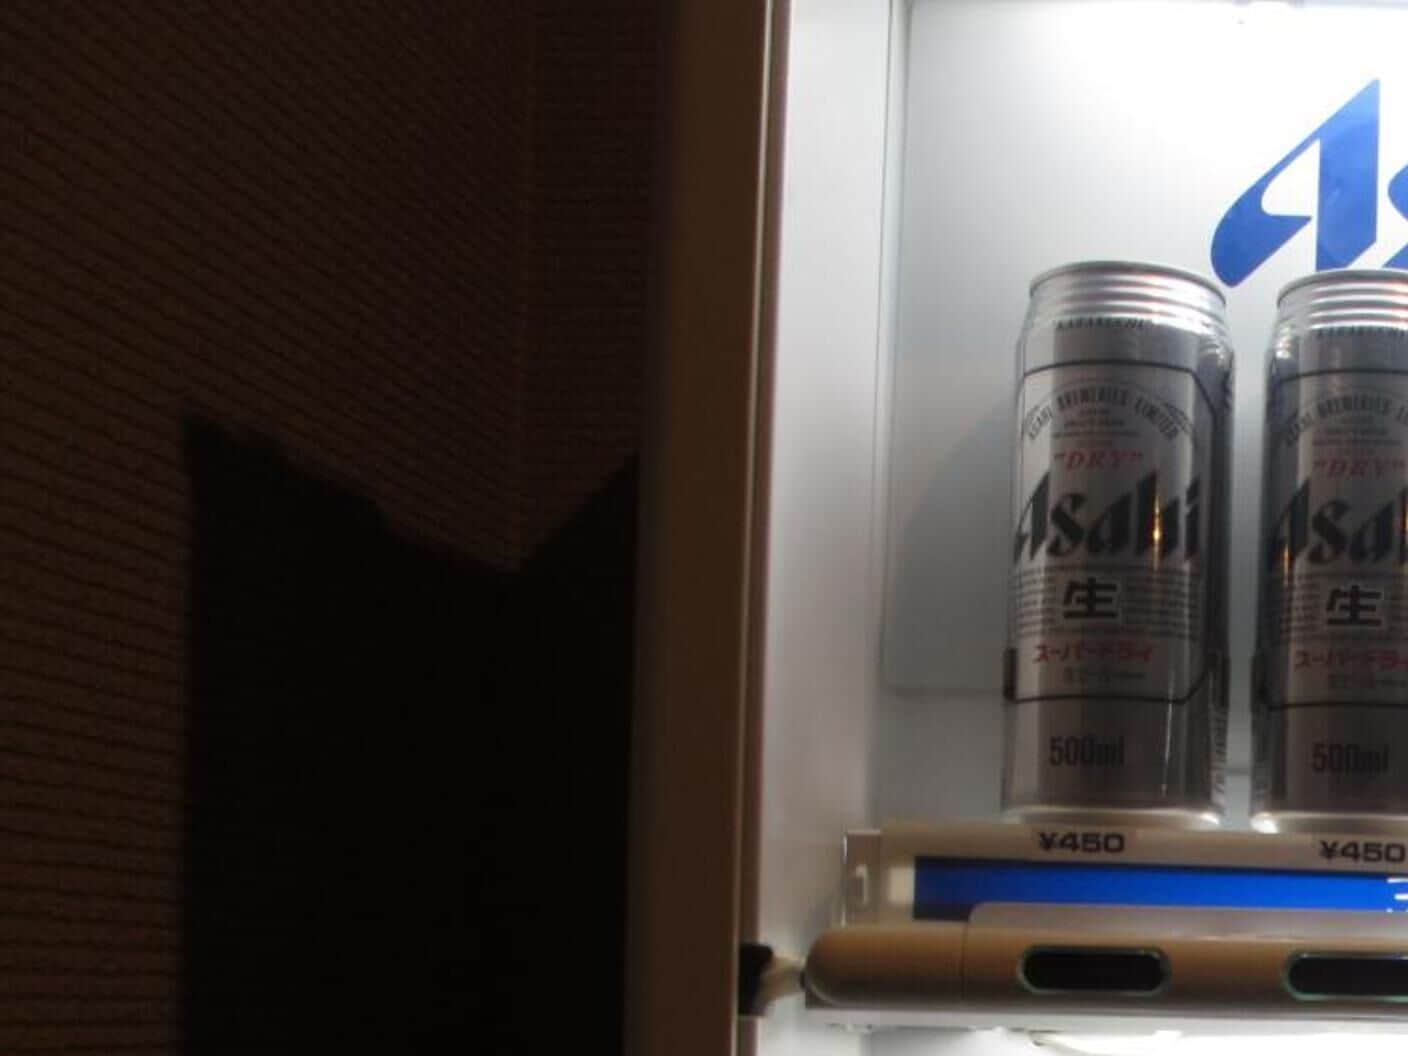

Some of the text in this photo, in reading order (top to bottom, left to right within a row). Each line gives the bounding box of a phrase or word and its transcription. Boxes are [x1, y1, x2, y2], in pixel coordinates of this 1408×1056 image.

[1011, 470, 1201, 562] Asahi
[1063, 577, 1118, 620] 生
[1326, 584, 1382, 627] 生
[1049, 735, 1125, 767] 500ml
[1312, 742, 1390, 774] 500ml
[1038, 831, 1126, 855] ¥450
[1320, 841, 1407, 865] ¥450
